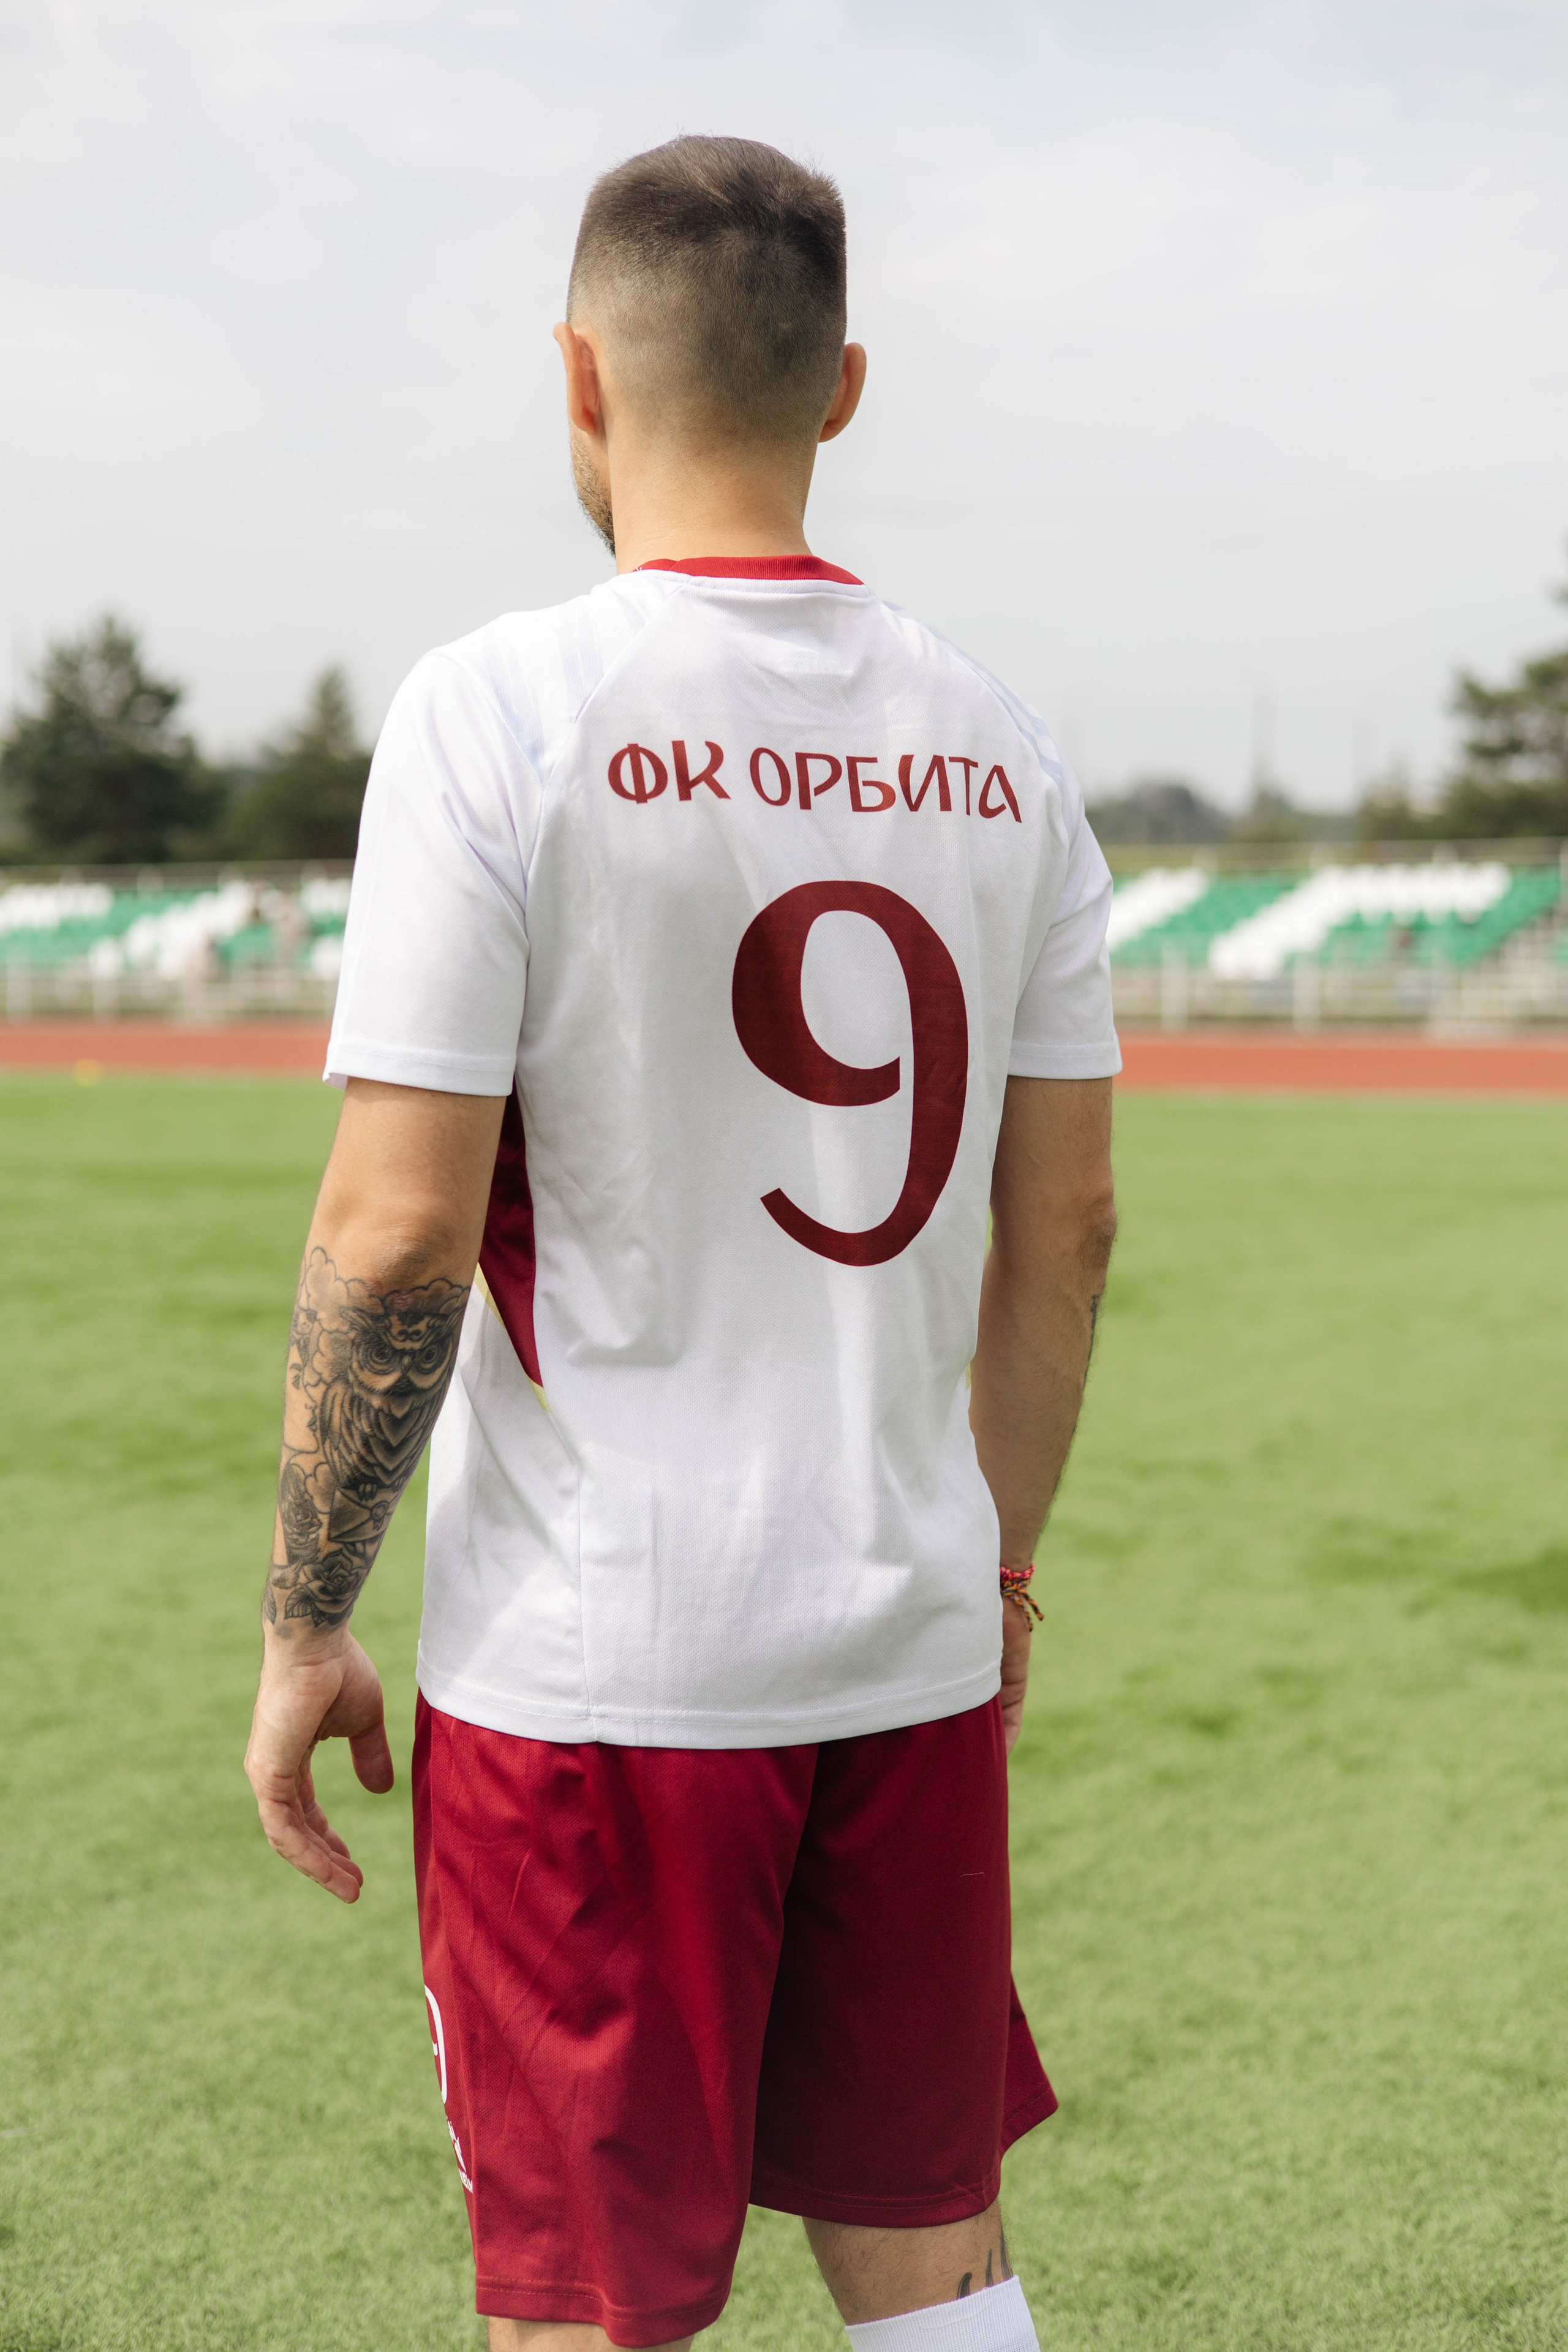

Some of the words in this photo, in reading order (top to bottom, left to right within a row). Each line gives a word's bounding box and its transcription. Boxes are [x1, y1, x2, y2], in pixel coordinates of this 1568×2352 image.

[608, 741, 731, 804] ФК
[749, 747, 1022, 823] ОРБИТА
[731, 880, 968, 1267] 9
